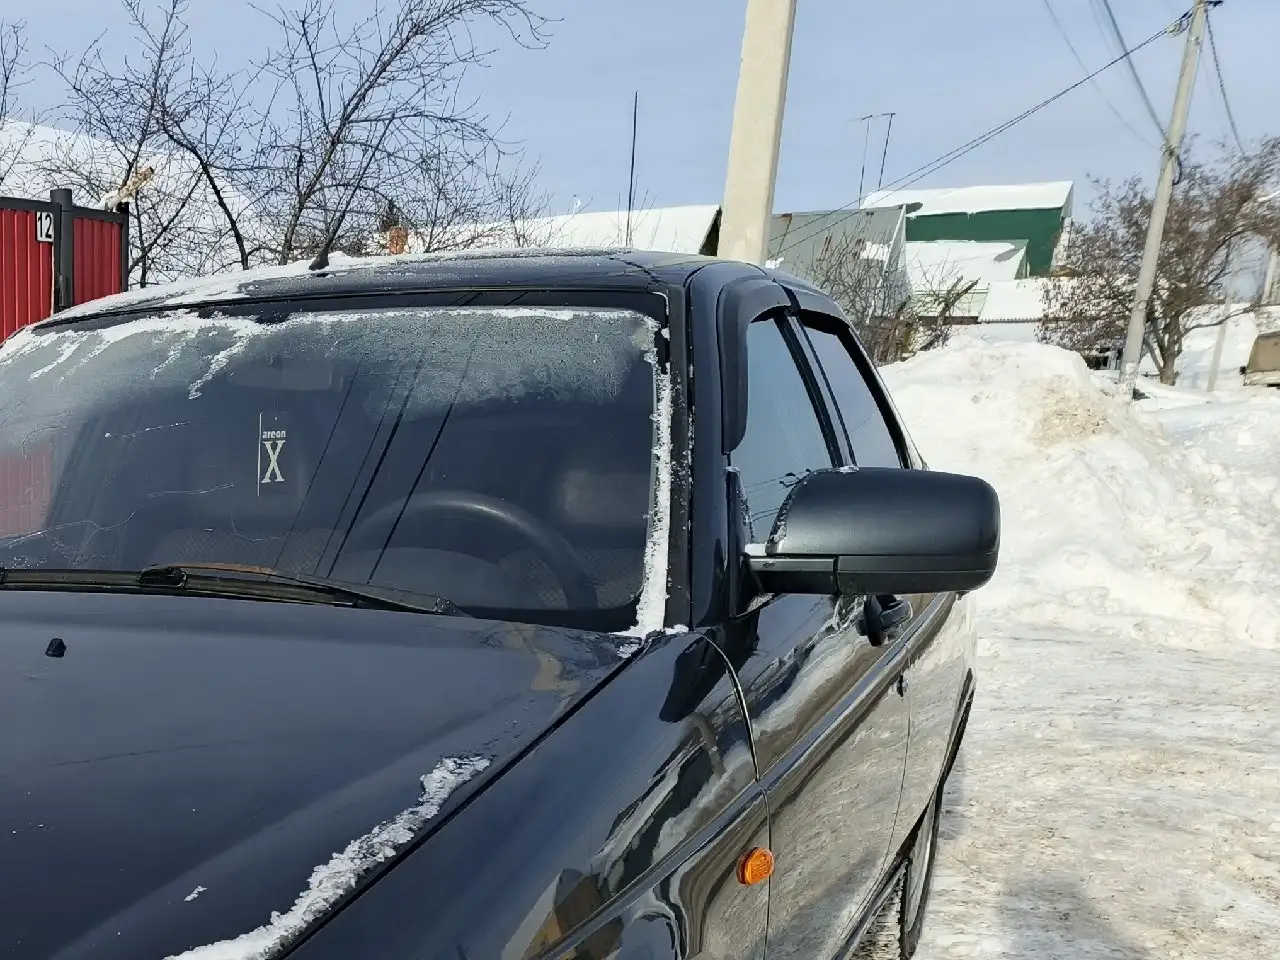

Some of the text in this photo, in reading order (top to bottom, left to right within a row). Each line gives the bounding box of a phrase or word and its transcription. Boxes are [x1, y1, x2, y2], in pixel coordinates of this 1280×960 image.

[37, 211, 53, 239] 12
[262, 430, 286, 439] areon
[261, 440, 286, 483] X
